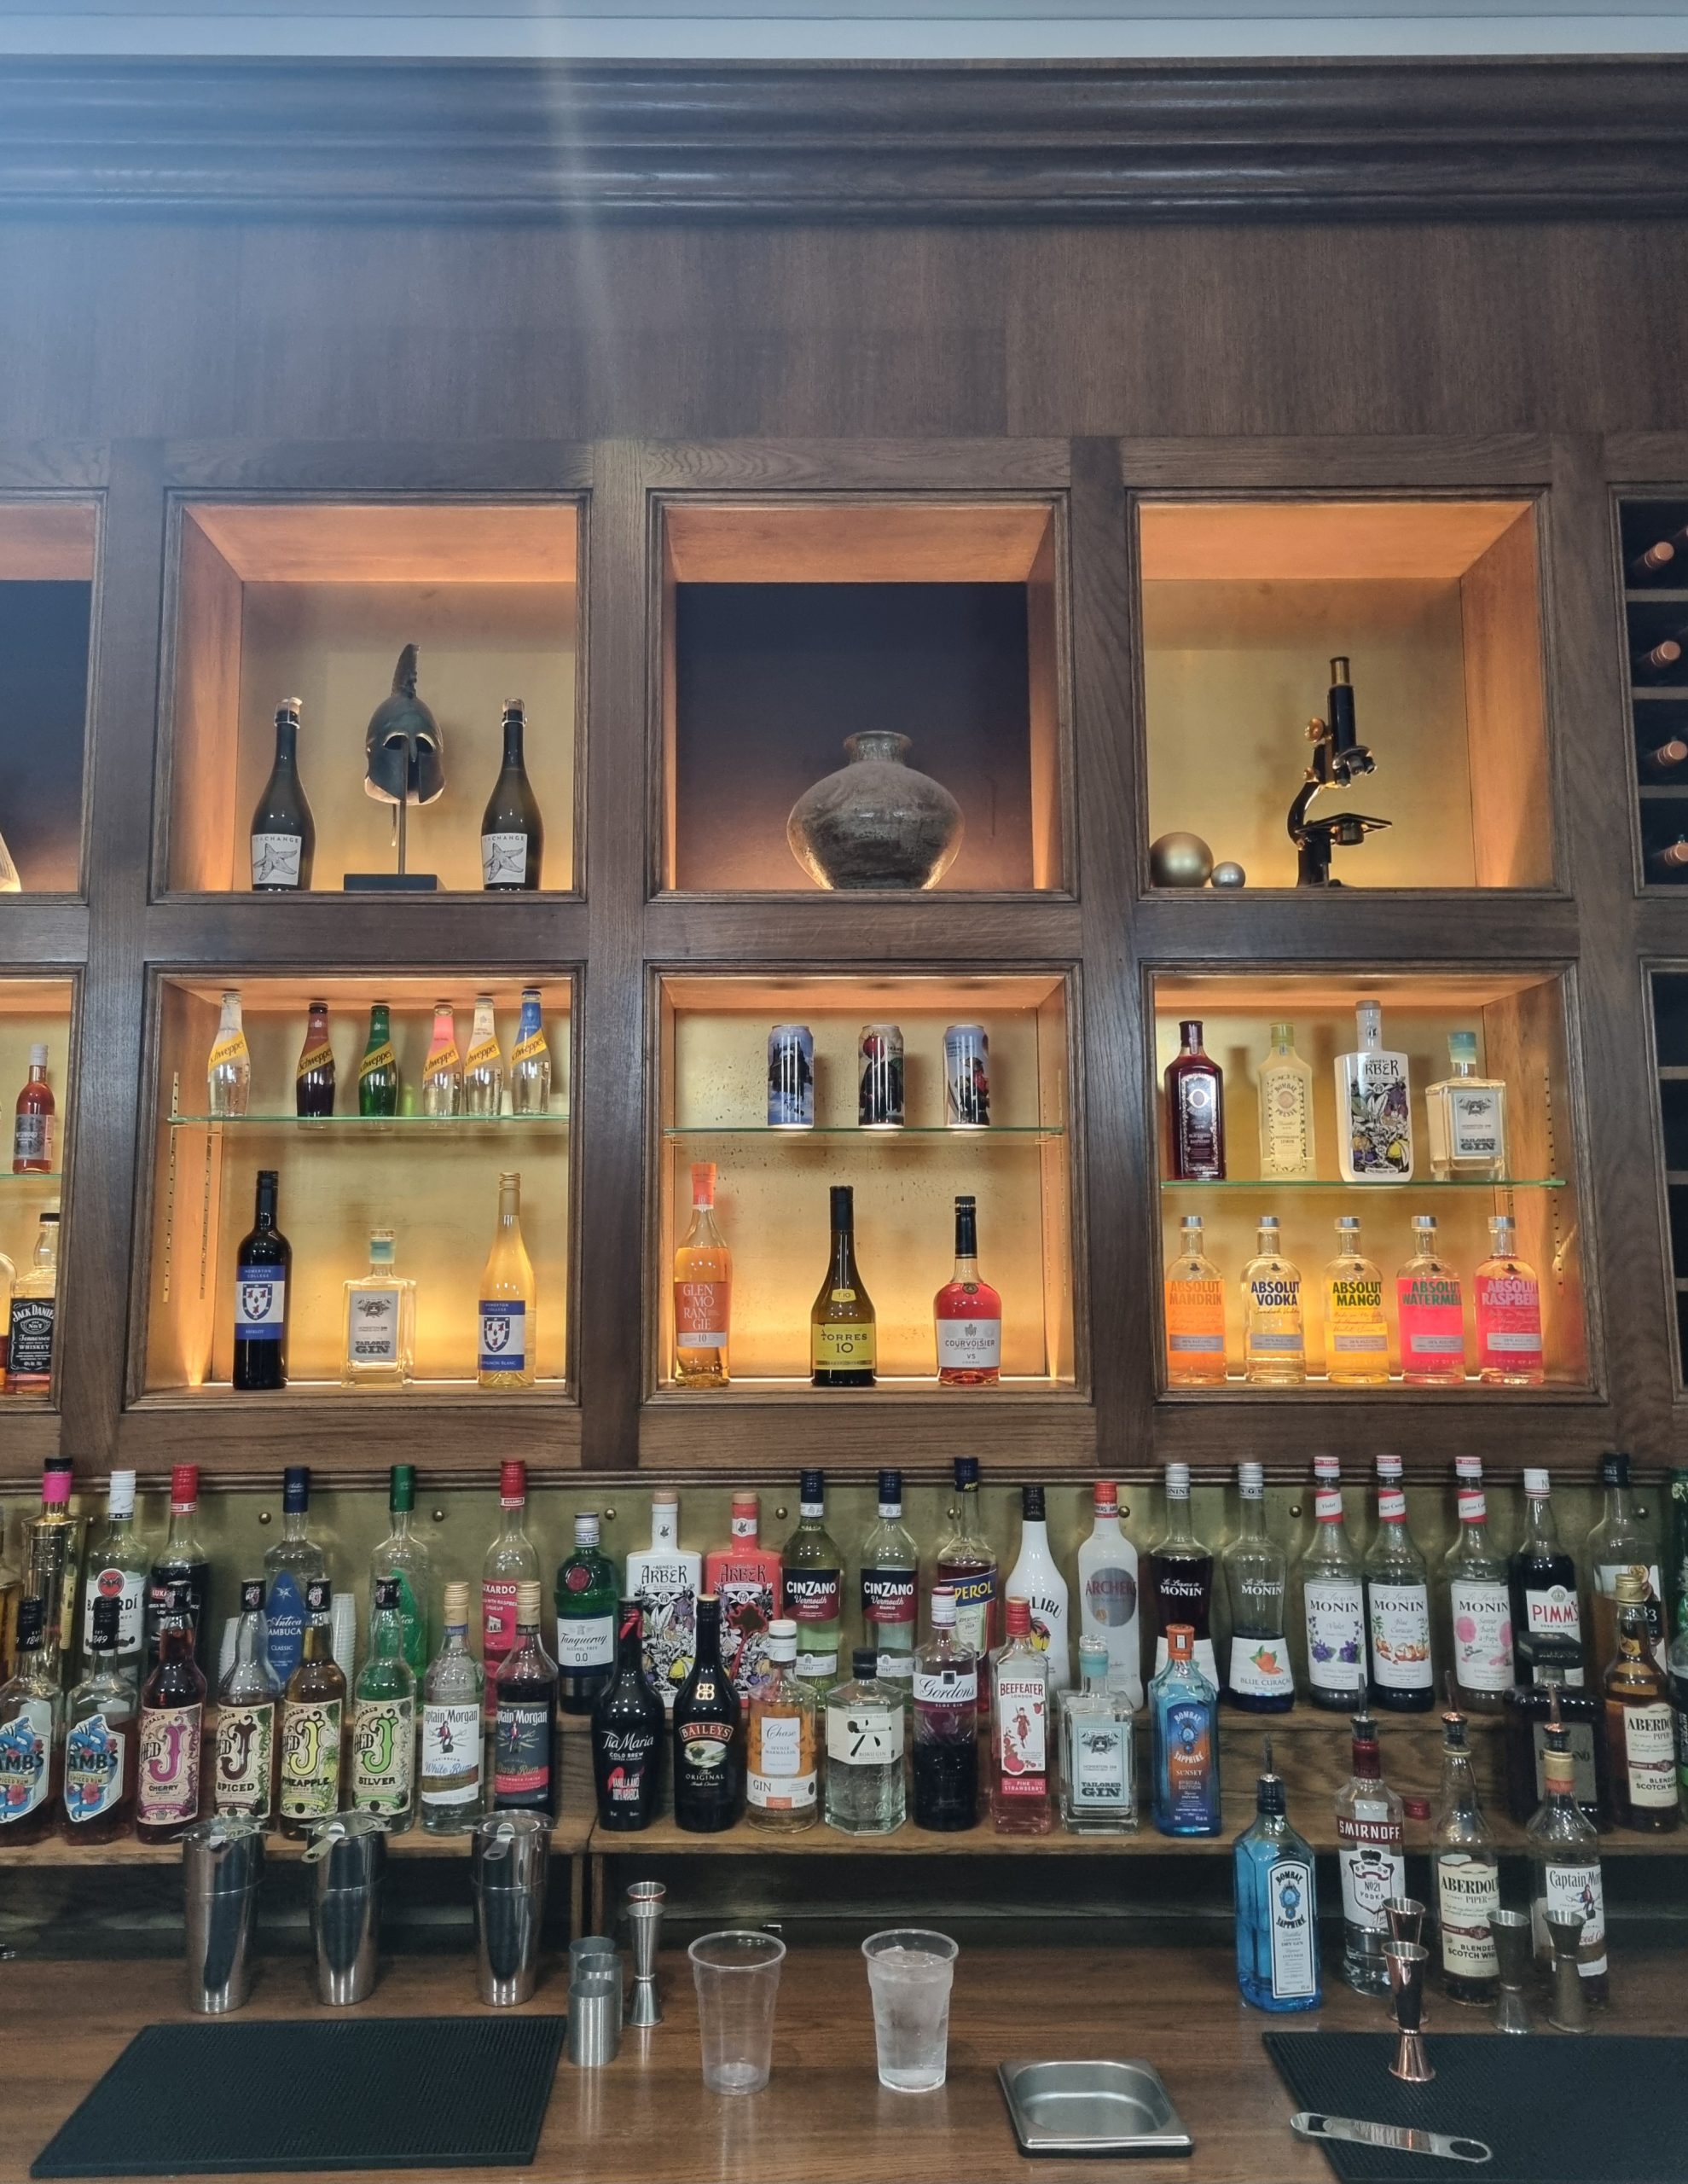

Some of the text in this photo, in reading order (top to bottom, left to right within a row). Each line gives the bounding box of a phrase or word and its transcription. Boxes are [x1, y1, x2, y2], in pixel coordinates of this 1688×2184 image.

[210, 1039, 245, 1063] chweppes
[465, 1043, 497, 1066] chweppes
[512, 1037, 544, 1061] chweppes
[360, 1048, 392, 1072] chweppes
[425, 1048, 455, 1072] chweppes
[1365, 1060, 1399, 1077] RBER
[1274, 1082, 1297, 1094] BOMBAY
[683, 1283, 713, 1296] GLEN
[1170, 1282, 1220, 1292] ABSOLUT
[1250, 1281, 1300, 1293] ABSOLUT
[1332, 1281, 1381, 1293] ABSOLUT
[693, 1296, 714, 1307] MO
[1169, 1293, 1221, 1305] MANDRIN
[1256, 1294, 1298, 1306] VODKA
[1337, 1295, 1380, 1307] MANGO
[12, 1307, 31, 1322] JACK
[684, 1308, 707, 1319] RAN
[693, 1319, 711, 1331] GIE
[698, 1334, 706, 1343] 10
[821, 1330, 867, 1341] TORRES
[836, 1342, 854, 1353] 10
[945, 1339, 995, 1348] COURVOISIER
[641, 1565, 687, 1584] ARBER
[720, 1564, 766, 1583] ARBER
[483, 1584, 517, 1594] UXARDO
[786, 1581, 836, 1595] CINZANO
[864, 1582, 914, 1597] CINZANO
[955, 1582, 993, 1601] PEROL
[1160, 1585, 1202, 1597] MONIN
[1242, 1585, 1282, 1596] MONIN
[87, 1595, 136, 1612] BARDÍ
[794, 1595, 827, 1604] Vermouth
[871, 1596, 904, 1606] Vermouth
[1031, 1596, 1062, 1618] LIBU
[1310, 1600, 1359, 1612] MONIN
[1374, 1600, 1424, 1612] MONIN
[1459, 1600, 1508, 1612] MONIN
[1532, 1600, 1579, 1623] PIMM'S
[266, 1614, 302, 1626] Antica
[268, 1628, 302, 1636] AMBUCA
[560, 1632, 607, 1647] Tanqueray
[575, 1653, 588, 1662] 0.0
[919, 1679, 975, 1698] Gordon's
[1000, 1682, 1044, 1697] BEEFEATER
[425, 1710, 478, 1723] ptain Morgan
[498, 1710, 547, 1724] ptain Morgan
[1174, 1711, 1203, 1725] BOMBAY
[681, 1724, 730, 1740] BAILEYS
[766, 1723, 797, 1740] Chase
[290, 1718, 324, 1776] J
[355, 1734, 374, 1754] OLD
[363, 1718, 399, 1774] J
[601, 1731, 653, 1751] Tia Maria
[149, 1722, 188, 1783] J
[221, 1722, 258, 1781] J
[1174, 1751, 1204, 1764] SAPPHIRE
[68, 1752, 118, 1771] AMBS
[425, 1763, 446, 1774] White
[449, 1763, 473, 1774] Rum
[496, 1763, 539, 1774] Dark Rum
[217, 1783, 254, 1792] SPICED
[358, 1777, 396, 1786] SILVER
[629, 1777, 640, 1788] AND
[752, 1780, 771, 1792] GIN
[1004, 1785, 1044, 1793] STRAWBERRY
[1082, 1788, 1122, 1798] GIN
[1339, 1821, 1401, 1840] SMIRNOFF
[1275, 1870, 1304, 1885] BOMBAY
[1549, 1870, 1586, 1889] Captain
[1441, 1876, 1498, 1893] ABERDOU
[1360, 1891, 1385, 1901] VODKA
[1465, 1895, 1488, 1904] PIPER
[1275, 1914, 1307, 1930] SAPPHIRE
[1447, 1948, 1480, 1959] SCOTCH
[1460, 1943, 1495, 1952] BLENDED
